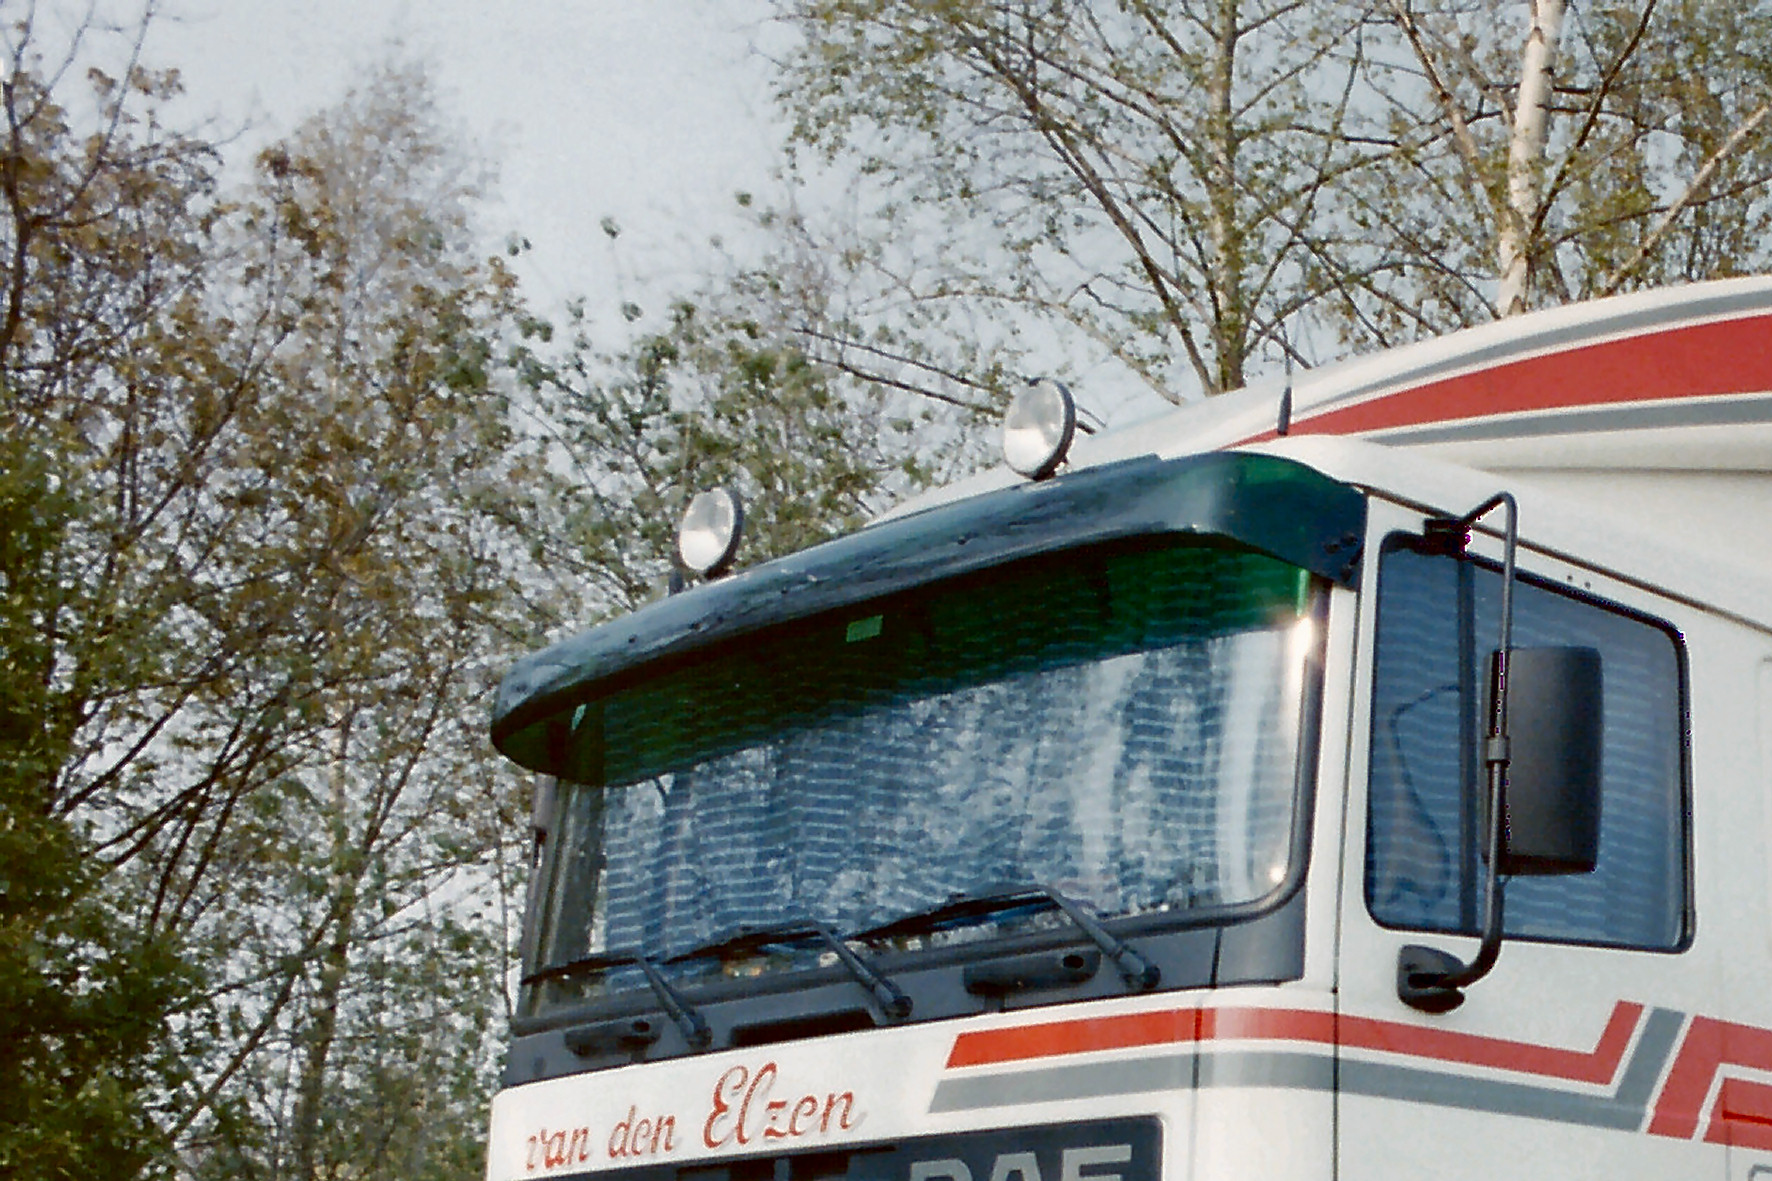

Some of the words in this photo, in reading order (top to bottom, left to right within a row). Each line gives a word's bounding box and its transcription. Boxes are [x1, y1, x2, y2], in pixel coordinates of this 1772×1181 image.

[526, 1126, 590, 1171] van
[608, 1104, 680, 1160] den
[702, 1062, 862, 1149] Elzen
